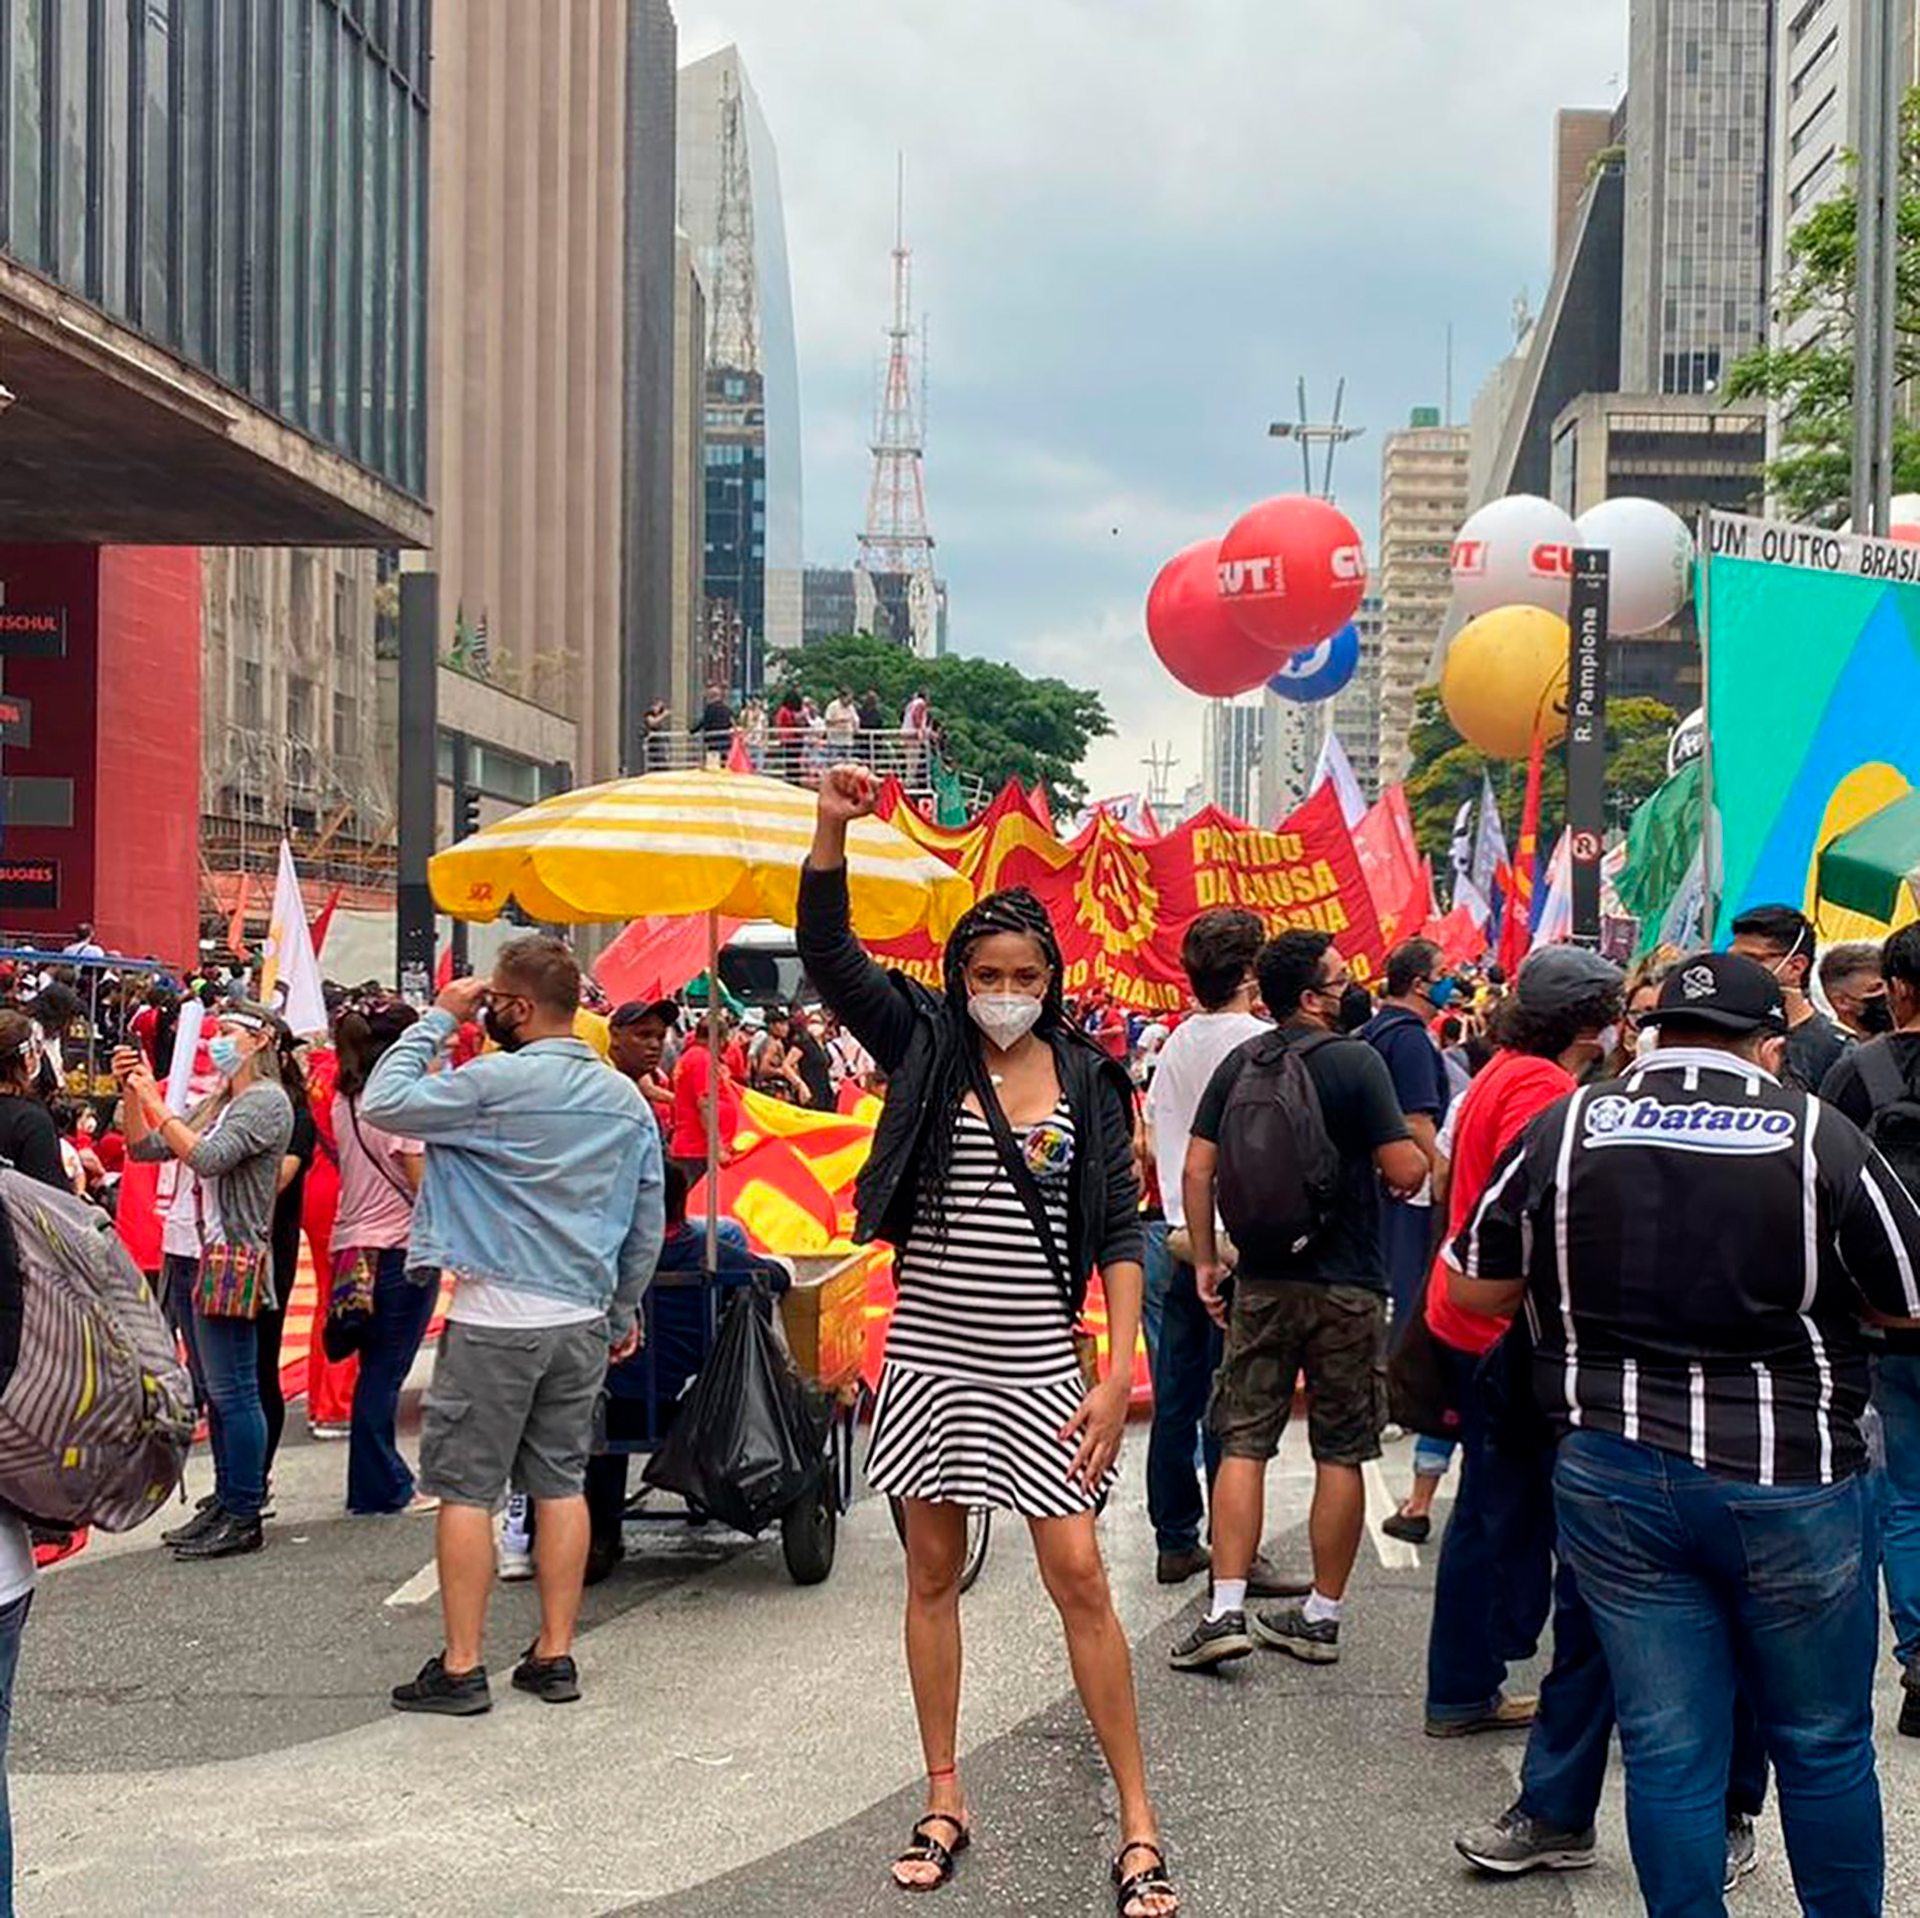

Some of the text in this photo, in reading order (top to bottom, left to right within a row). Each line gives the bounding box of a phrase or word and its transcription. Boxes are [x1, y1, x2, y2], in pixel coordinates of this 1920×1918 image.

[1710, 520, 1920, 582] UM OUTRO BRASI
[1217, 556, 1272, 593] UT
[1576, 606, 1599, 717] Pamplona
[1573, 720, 1592, 743] R.
[1194, 858, 1341, 908] DA CAUSA
[1629, 1100, 1791, 1134] batavo
